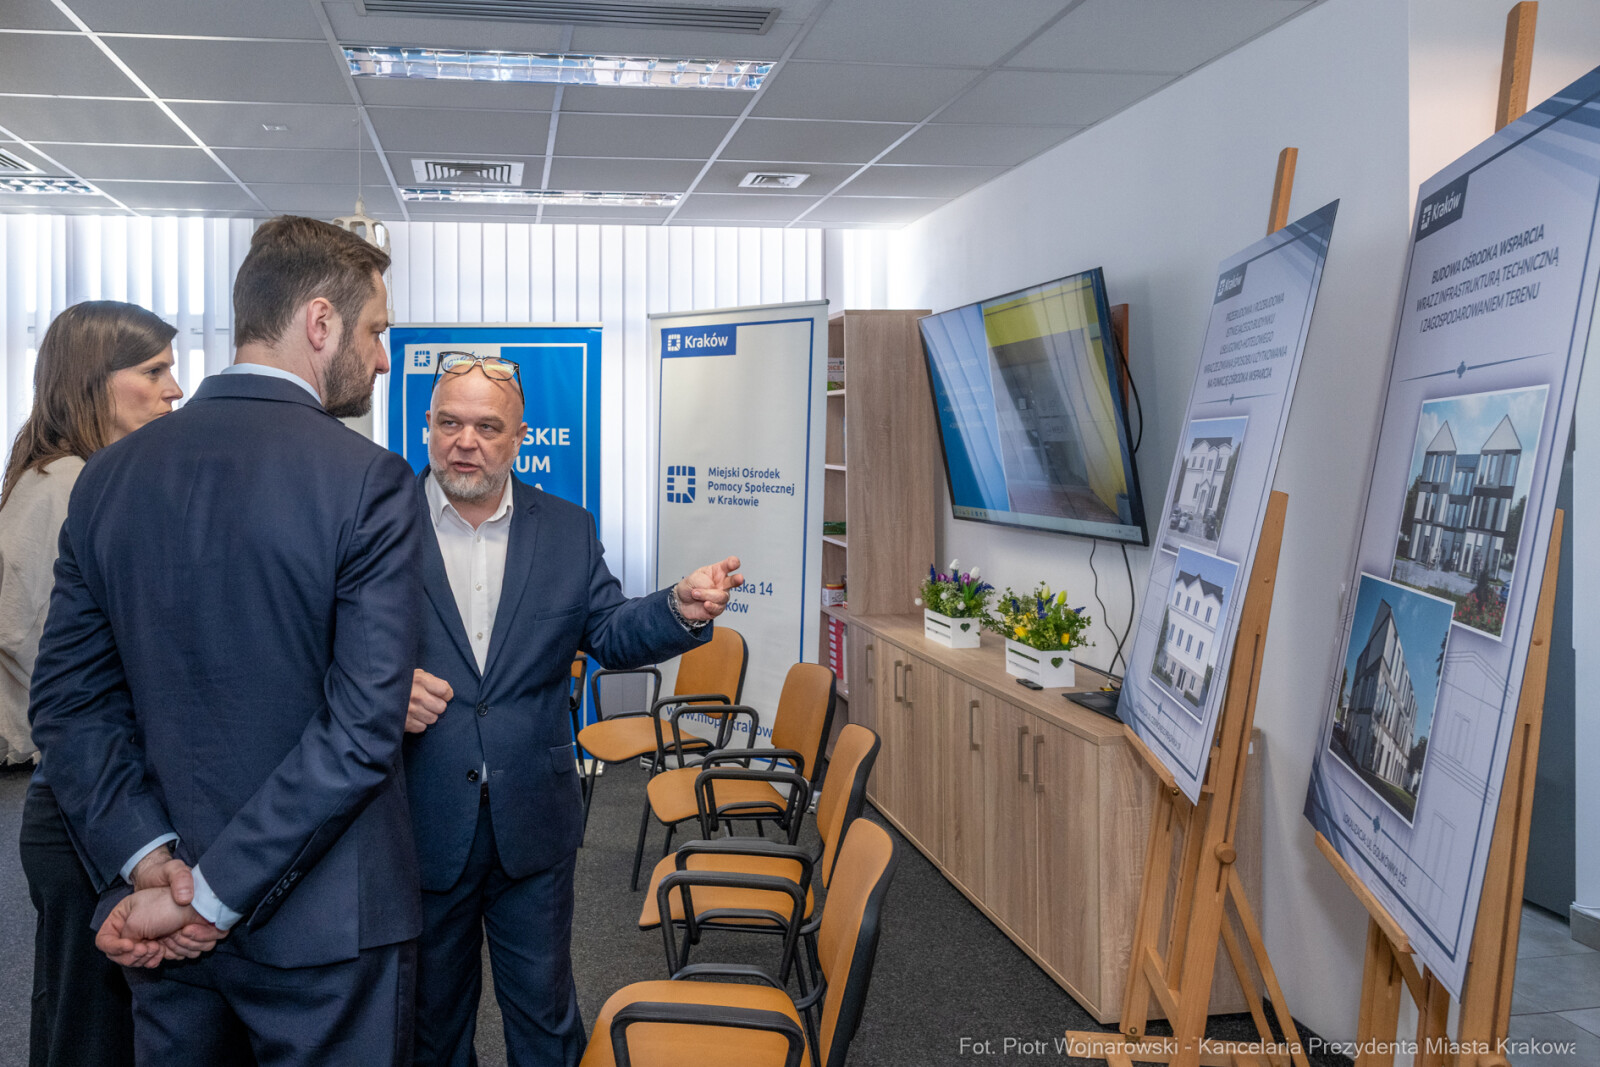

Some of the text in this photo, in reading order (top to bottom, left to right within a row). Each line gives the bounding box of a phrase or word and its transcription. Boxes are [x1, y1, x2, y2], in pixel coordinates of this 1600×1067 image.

[1431, 192, 1462, 222] Kraków
[1431, 224, 1544, 284] BUDOWA OŚRODKA WSPARCIA
[1415, 293, 1433, 312] WRAZ
[1439, 268, 1501, 304] INFRASTRUKTURĄ
[1501, 246, 1559, 280] TECHNICZNĄ
[1422, 293, 1504, 331] ZAGOSPODAROWANIEM
[1505, 282, 1540, 306] TERENU
[685, 333, 728, 348] Kraków
[708, 466, 780, 479] Miejski Ośrodek
[708, 481, 795, 496] Pomocy Społecznej
[718, 495, 759, 507] Krakowie
[759, 582, 773, 596] 14
